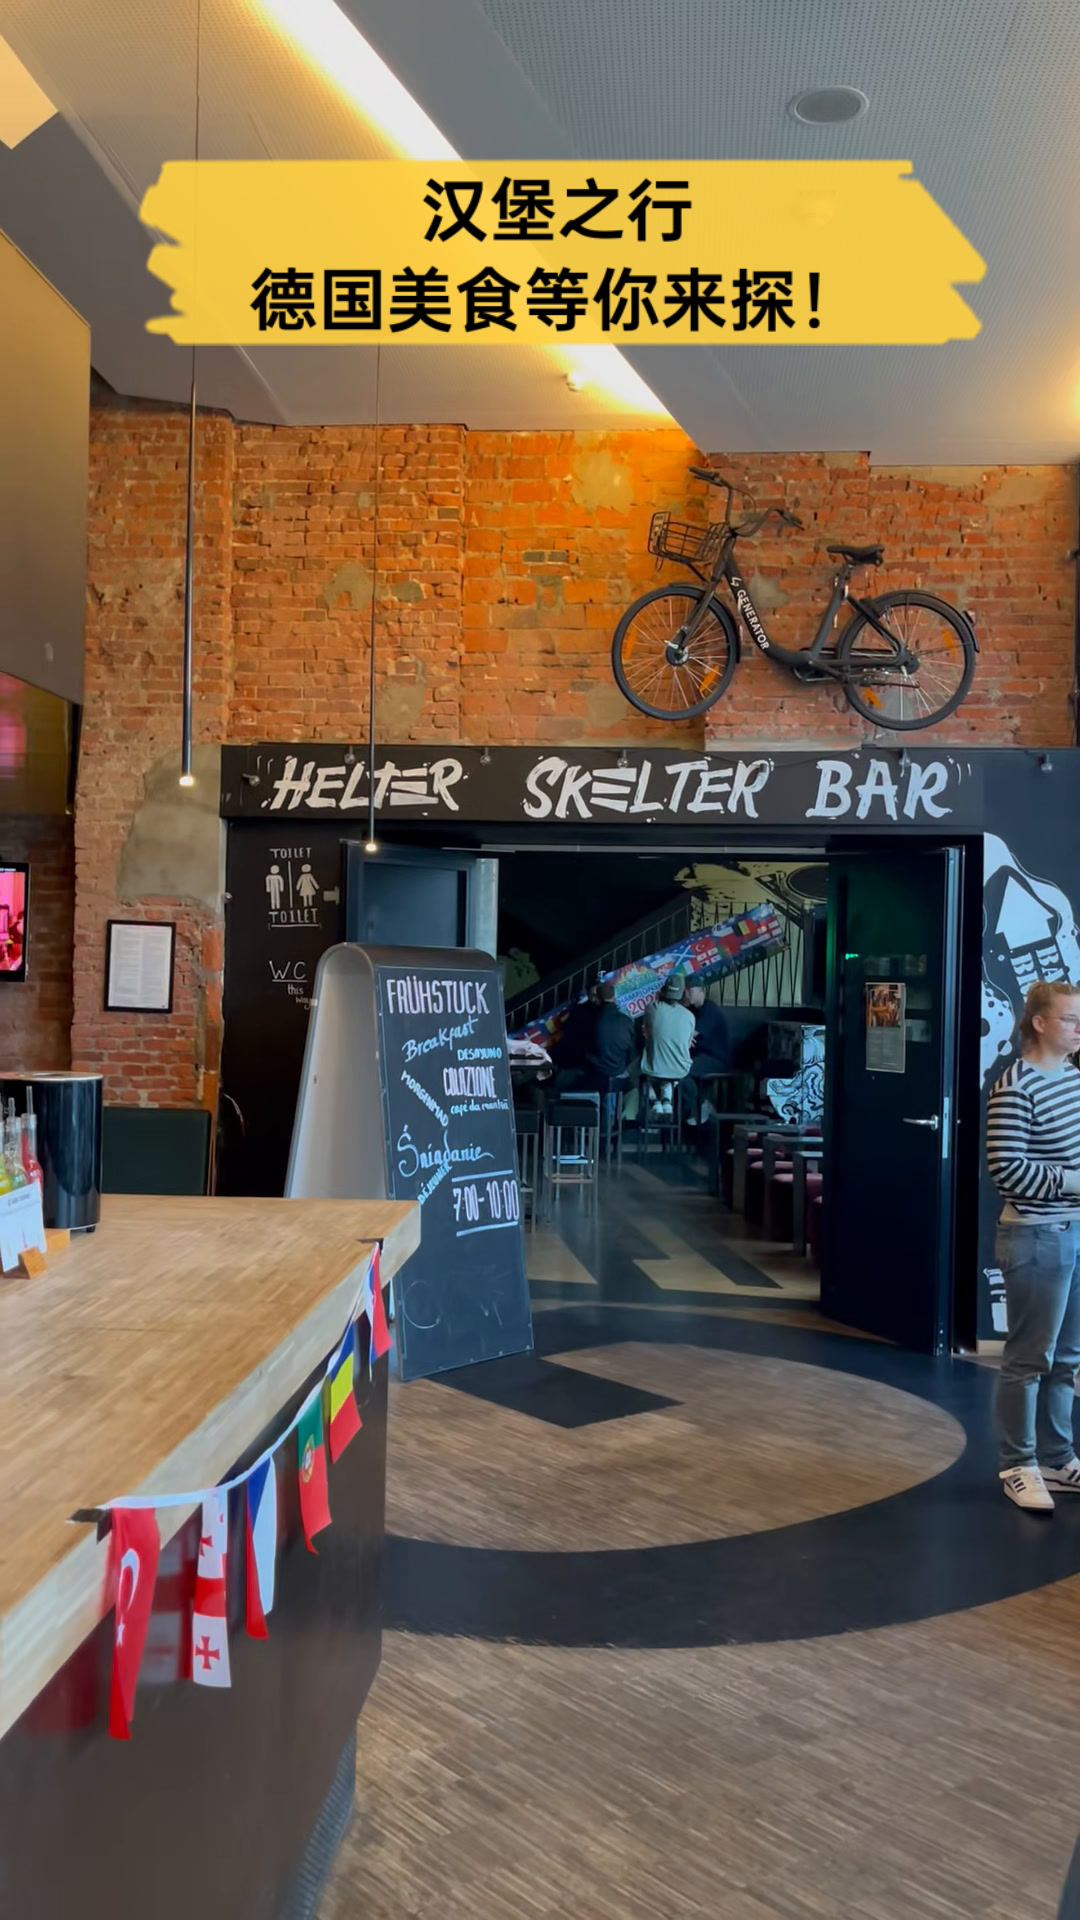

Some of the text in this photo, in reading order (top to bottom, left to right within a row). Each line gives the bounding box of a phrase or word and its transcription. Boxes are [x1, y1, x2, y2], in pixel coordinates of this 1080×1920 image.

[737, 589, 770, 650] GENERATOR
[270, 755, 952, 821] HELTER SKELTER BAR
[269, 847, 312, 859] TOILET
[269, 907, 319, 923] TOILET
[269, 960, 307, 980] WC
[287, 983, 305, 995] this
[295, 995, 318, 1010] way
[402, 1014, 479, 1063] Breakfast
[457, 1047, 502, 1061] DESAYUNO
[443, 1065, 497, 1099] COLAZIONE
[469, 1098, 481, 1112] da
